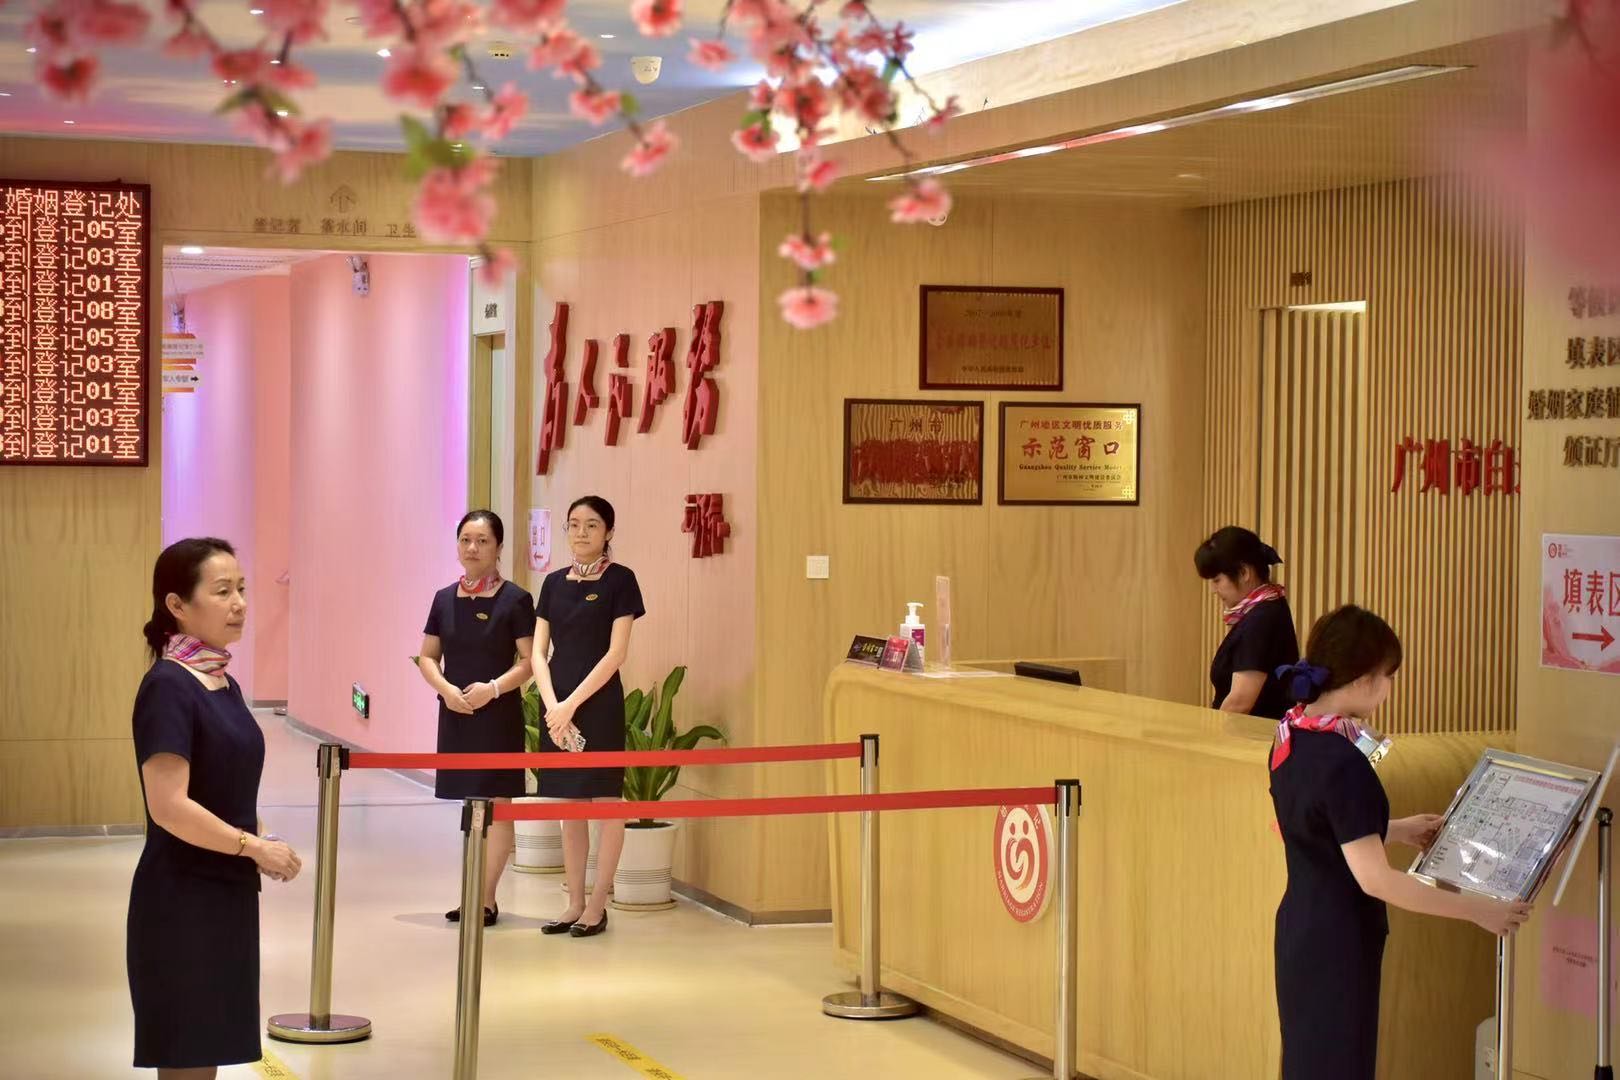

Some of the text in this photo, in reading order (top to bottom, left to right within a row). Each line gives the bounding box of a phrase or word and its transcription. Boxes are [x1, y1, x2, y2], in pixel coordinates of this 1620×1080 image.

[0, 187, 141, 219] 婚姻登记处
[385, 223, 418, 239] 卫生
[1527, 386, 1620, 421] 婚姻家庭辅
[888, 416, 945, 433] 广州市
[1019, 419, 1123, 431] 广州地区文明优质服务
[1021, 434, 1121, 462] 示范窗口
[1019, 463, 1052, 471] Guangzhou
[1054, 463, 1077, 472] Quality
[1079, 463, 1102, 471] Service
[1391, 436, 1520, 497] 广州市白
[1563, 567, 1620, 617] 填表区
